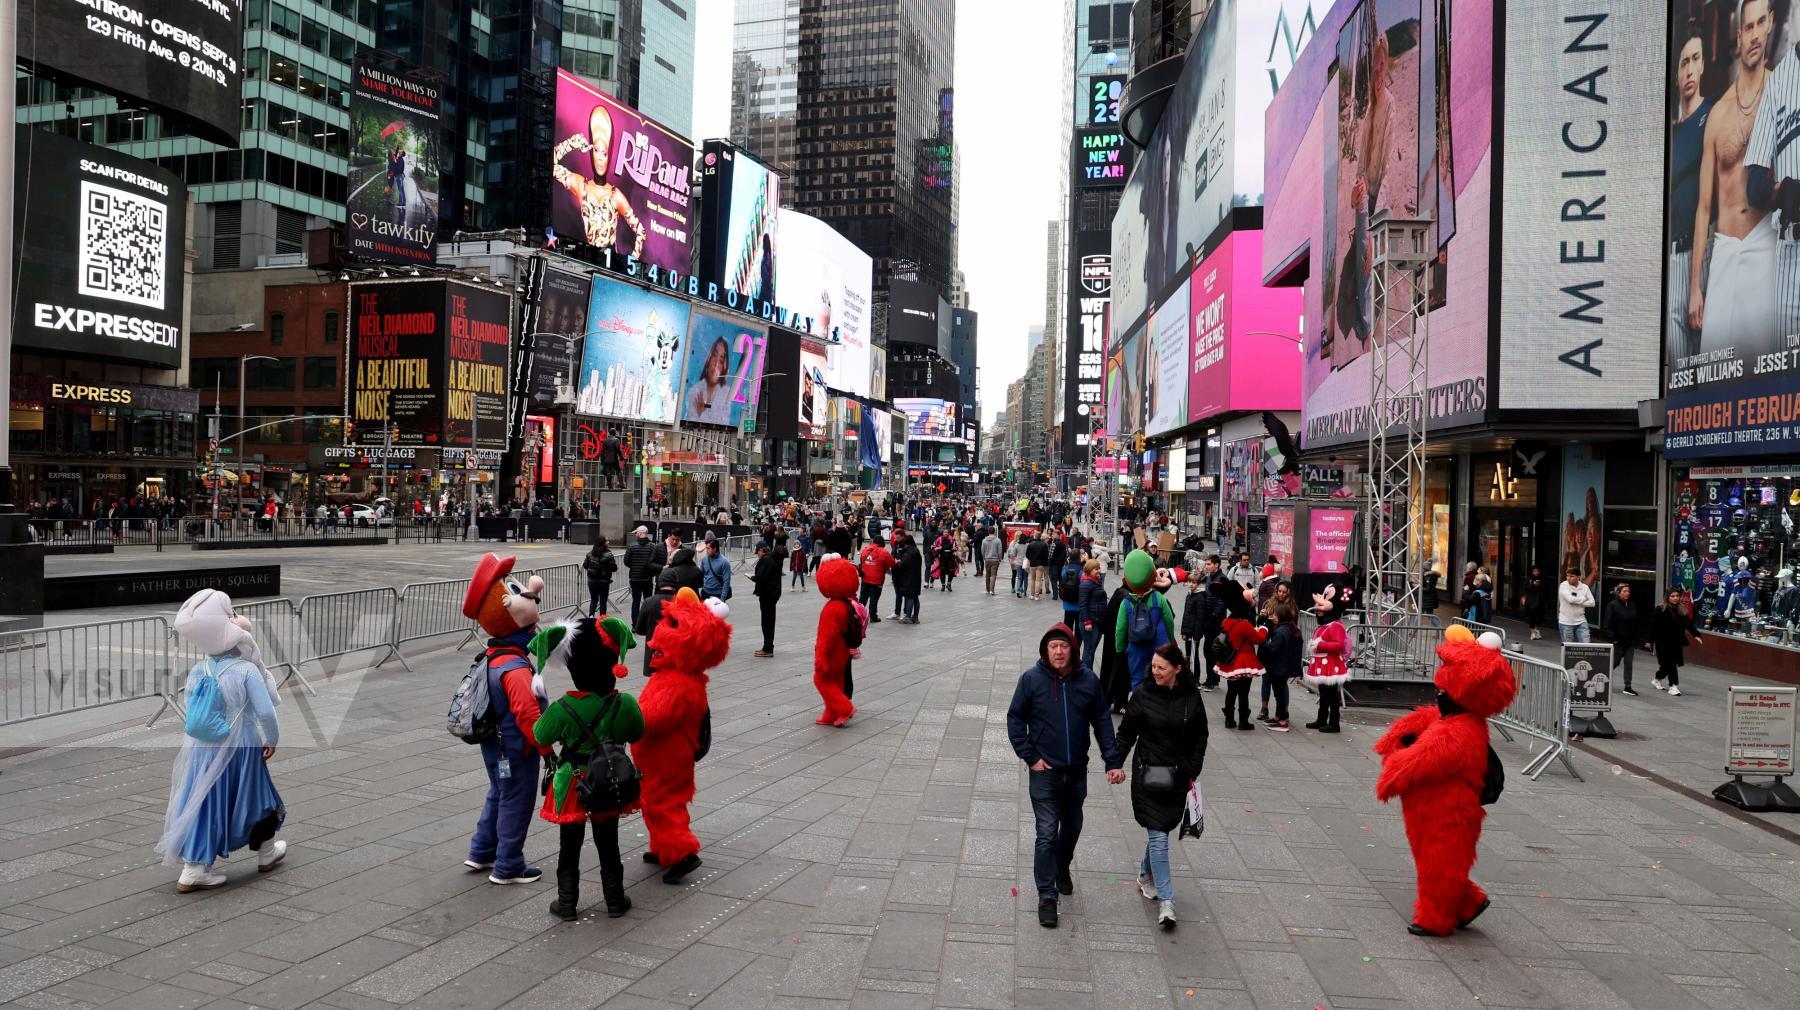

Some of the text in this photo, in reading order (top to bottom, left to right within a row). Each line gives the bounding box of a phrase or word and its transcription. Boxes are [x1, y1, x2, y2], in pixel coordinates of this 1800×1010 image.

[86, 14, 228, 88] 129 Fifth Ave. @ 20th St.
[151, 19, 201, 51] OPENS
[202, 41, 228, 67] SEPT.
[359, 66, 437, 99] A MILLION WAYS TO
[391, 86, 412, 101] YOUR
[1095, 82, 1122, 101] 20
[1095, 104, 1120, 123] 23
[1083, 135, 1124, 149] HAPPY
[1088, 149, 1120, 163] NEW
[80, 159, 169, 197] SCAN FOR DETAILS
[705, 167, 716, 175] LG
[1085, 166, 1124, 178] YEAR!
[649, 181, 688, 207] DRAG RACE
[1558, 13, 1609, 378] AMERICAN
[371, 214, 434, 249] tawkify
[650, 219, 675, 240] Now on
[355, 239, 374, 249] DATE
[1085, 267, 1111, 276] NFL
[603, 247, 815, 334] 1540 BROADWAY
[360, 293, 378, 315] THE
[452, 295, 467, 317] THE
[359, 312, 435, 336] NEIL DIAMOND
[451, 316, 508, 345] NEIL DIAMOND
[358, 335, 400, 358] MUSICAL
[450, 336, 482, 361] MUSICAL
[1079, 353, 1101, 365] SEAS
[1754, 351, 1788, 375] JESSE
[356, 358, 430, 390] A BEAUTIFUL
[449, 359, 455, 388] A
[458, 360, 505, 394] BEAUTIFUL
[1669, 360, 1744, 389] JESSE WILLIAMS
[52, 383, 132, 404] EXPRESS
[355, 390, 390, 421] NOISE
[1307, 408, 1355, 441] AMERICAN
[1667, 401, 1732, 434] THROUGH
[1672, 436, 1694, 448] GERALD
[1695, 431, 1732, 446] SCHOENFELD
[1734, 428, 1764, 442] THEATRE,
[1766, 428, 1780, 440] 236
[1782, 427, 1792, 440] W.
[325, 448, 416, 459] GIFTS LUGGAGE
[443, 449, 465, 459] GIFTS
[1709, 487, 1717, 500] 8
[1708, 516, 1722, 527] 17
[1708, 539, 1719, 554] 2
[132, 573, 270, 592] FATHER DUFFY SQUARE
